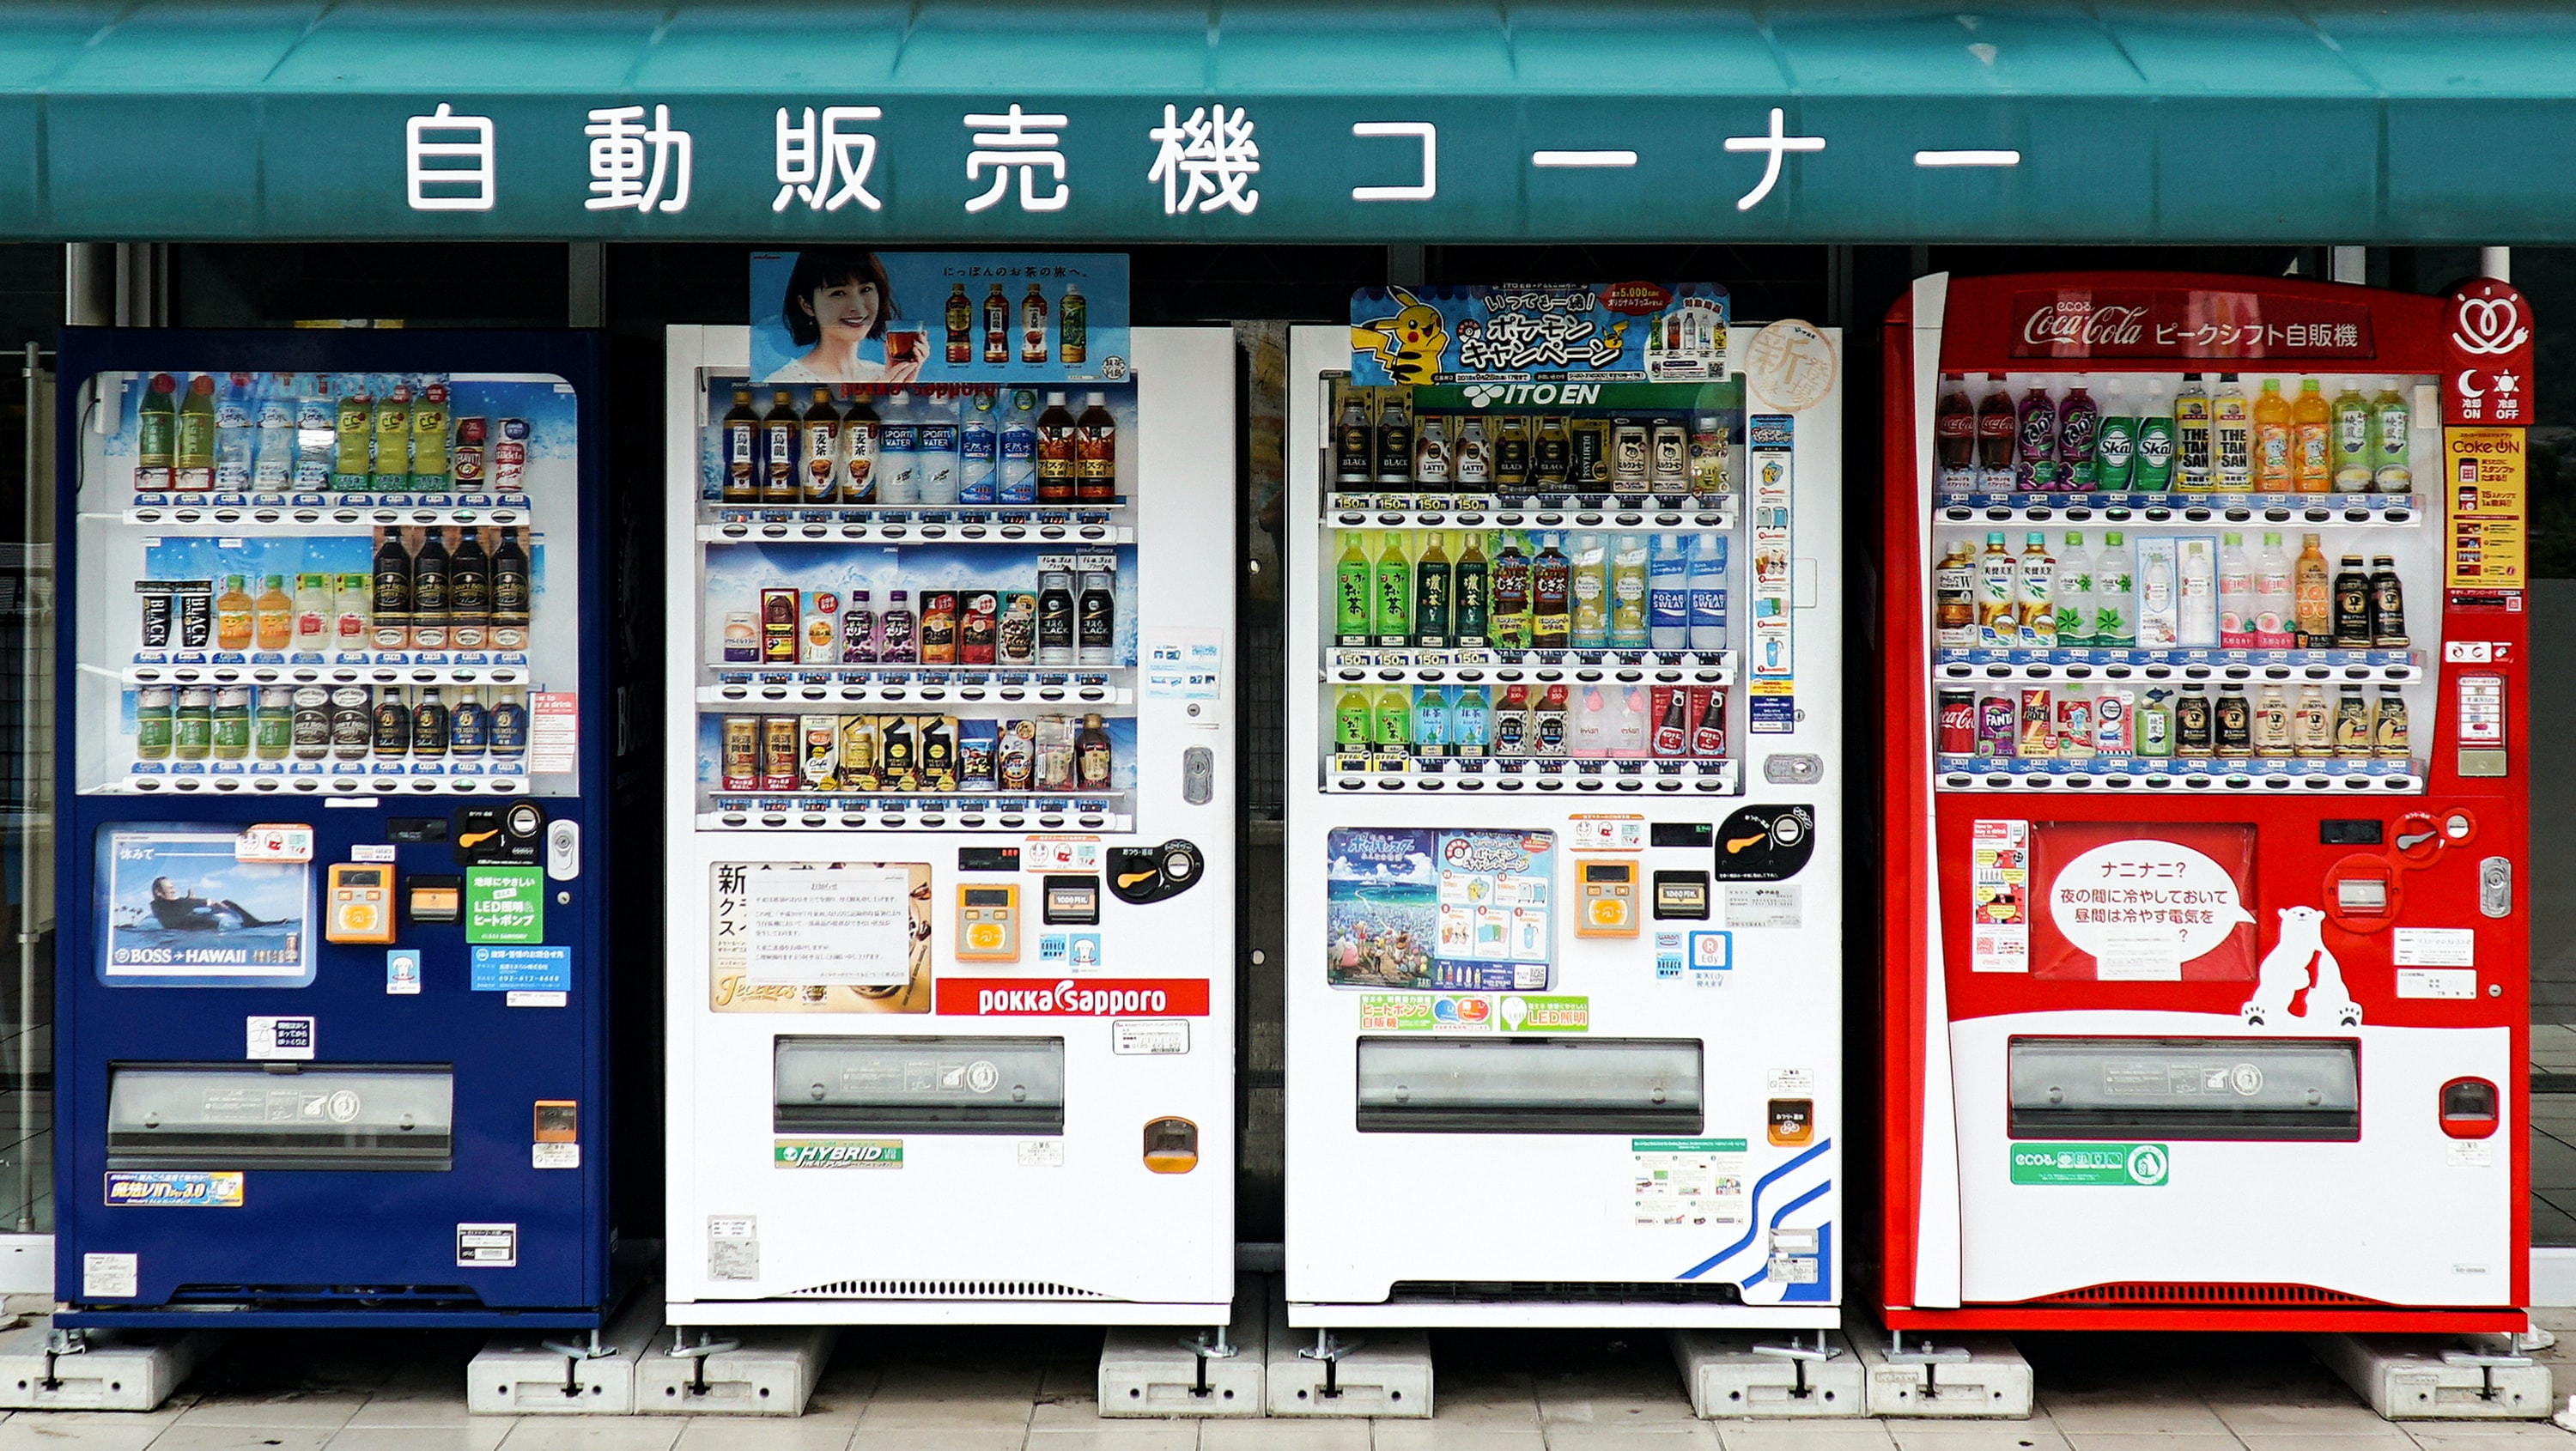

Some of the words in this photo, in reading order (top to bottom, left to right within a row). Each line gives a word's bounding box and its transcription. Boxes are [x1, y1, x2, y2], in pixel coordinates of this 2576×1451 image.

[405, 103, 2021, 216] 自動販売機コーナー
[1486, 313, 1595, 345] ポケモン
[2024, 305, 2148, 345] Coca-Cola
[2155, 321, 2359, 348] ピークシフト自販機
[1460, 337, 1623, 370] キャンペーン
[1504, 384, 1558, 405] ITO
[1559, 384, 1601, 405] EN
[2463, 409, 2481, 419] ON
[2495, 410, 2519, 420] OFF
[922, 429, 951, 439] SPORTS
[2183, 428, 2208, 441] THE
[2221, 428, 2247, 441] THE
[885, 439, 911, 447] WATER
[923, 439, 949, 447] WATER
[2183, 441, 2208, 454] TAN
[2221, 441, 2247, 454] TAN
[2452, 440, 2493, 453] Coke
[2495, 439, 2520, 453] ON
[2183, 454, 2209, 468] SAN
[2221, 454, 2247, 468] SAN
[1496, 576, 1528, 590] むぎ茶
[1538, 579, 1565, 592] むぎ茶
[1960, 575, 1972, 589] W
[150, 599, 165, 644] BLACK
[191, 598, 206, 644] BLACK
[2101, 861, 2186, 879] ナニナニ?
[717, 864, 747, 895] 新
[2061, 889, 2227, 905] 夜の間に冷やしておいて
[474, 914, 535, 926] ヒートポンプ
[2075, 908, 2214, 925] 昼間は冷やす電気を
[2179, 928, 2188, 943] ?
[131, 949, 172, 963] BOSS
[185, 949, 246, 963] HAWAII
[1701, 954, 1719, 964] Edy
[1363, 1004, 1430, 1016] ヒートポンプ
[1363, 1017, 1398, 1029] 自販機
[1528, 1011, 1588, 1026] LED照明
[798, 1146, 882, 1165] HYBRID
